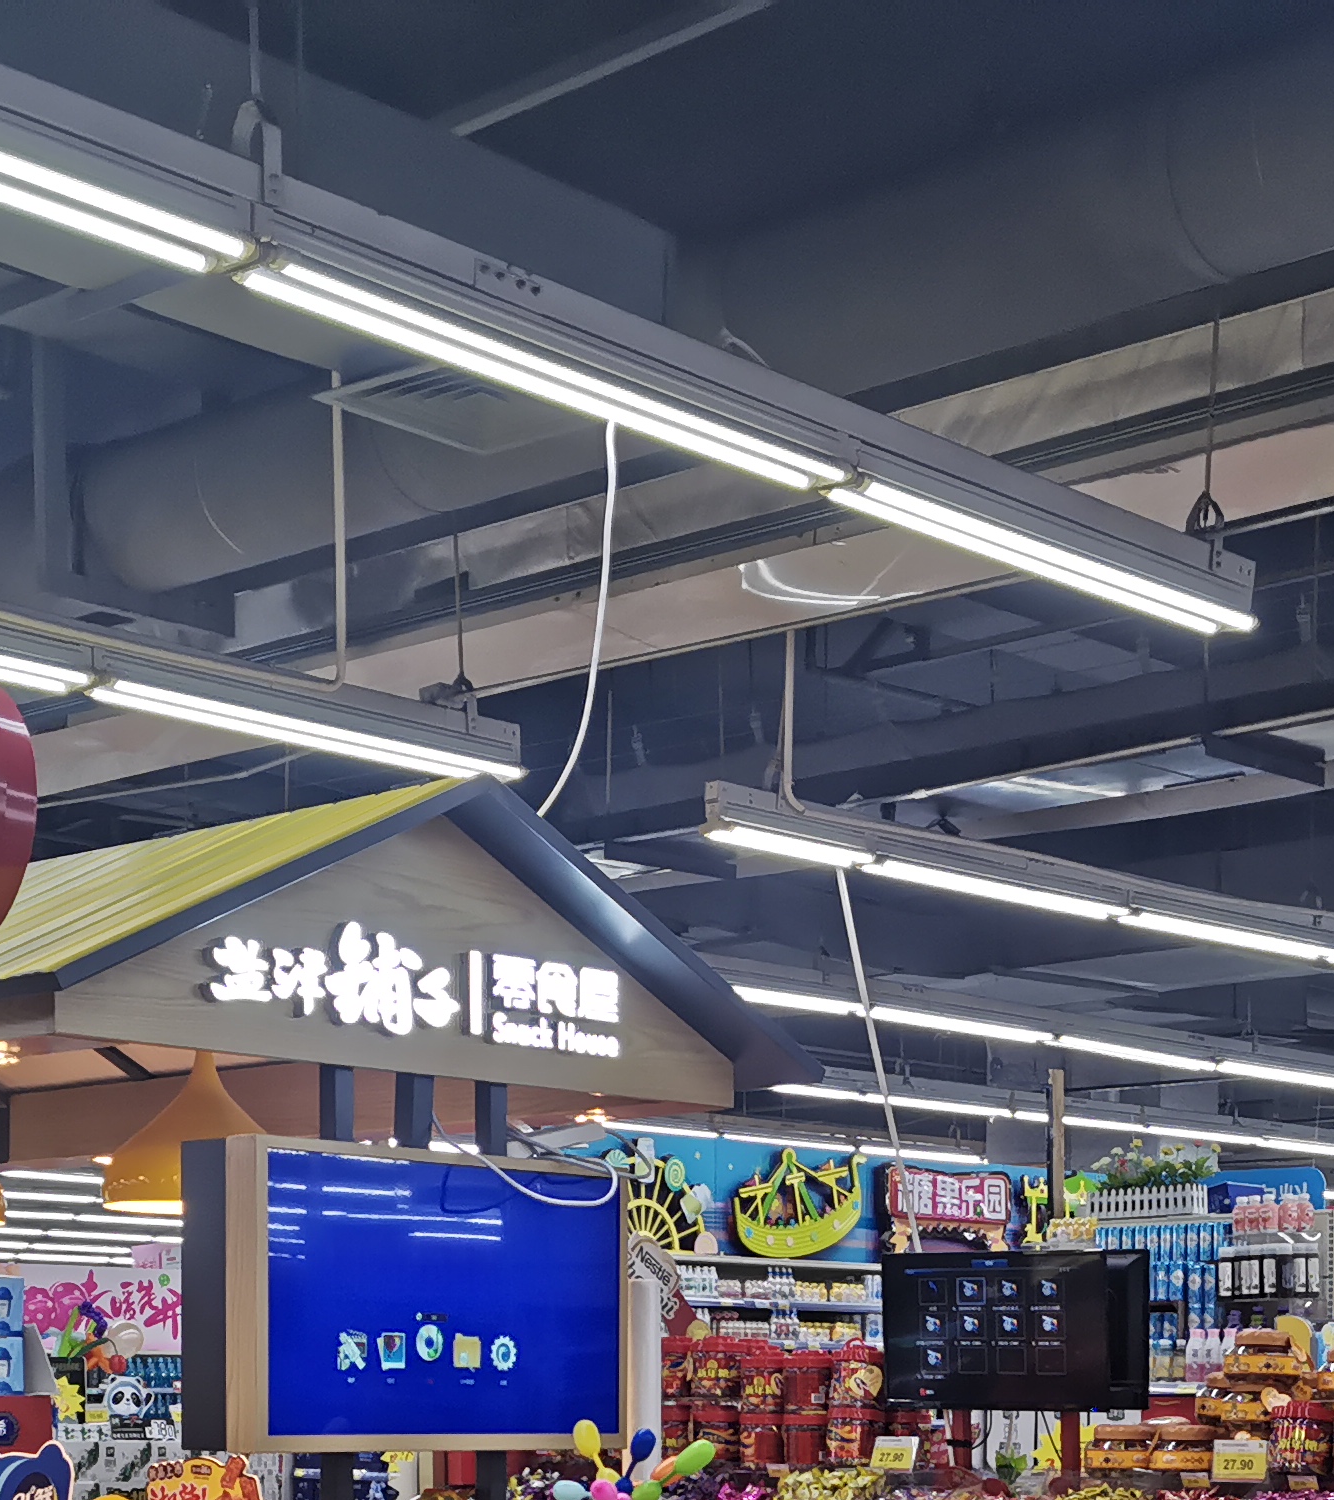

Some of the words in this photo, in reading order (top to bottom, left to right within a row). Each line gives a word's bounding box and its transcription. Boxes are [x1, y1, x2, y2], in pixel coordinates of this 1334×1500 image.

[492, 953, 620, 1023] 零食屋
[492, 1012, 553, 1050] Snack
[558, 1021, 620, 1058] House
[896, 1170, 1008, 1221] 糖果乐园
[1222, 1458, 1254, 1472] 27.90
